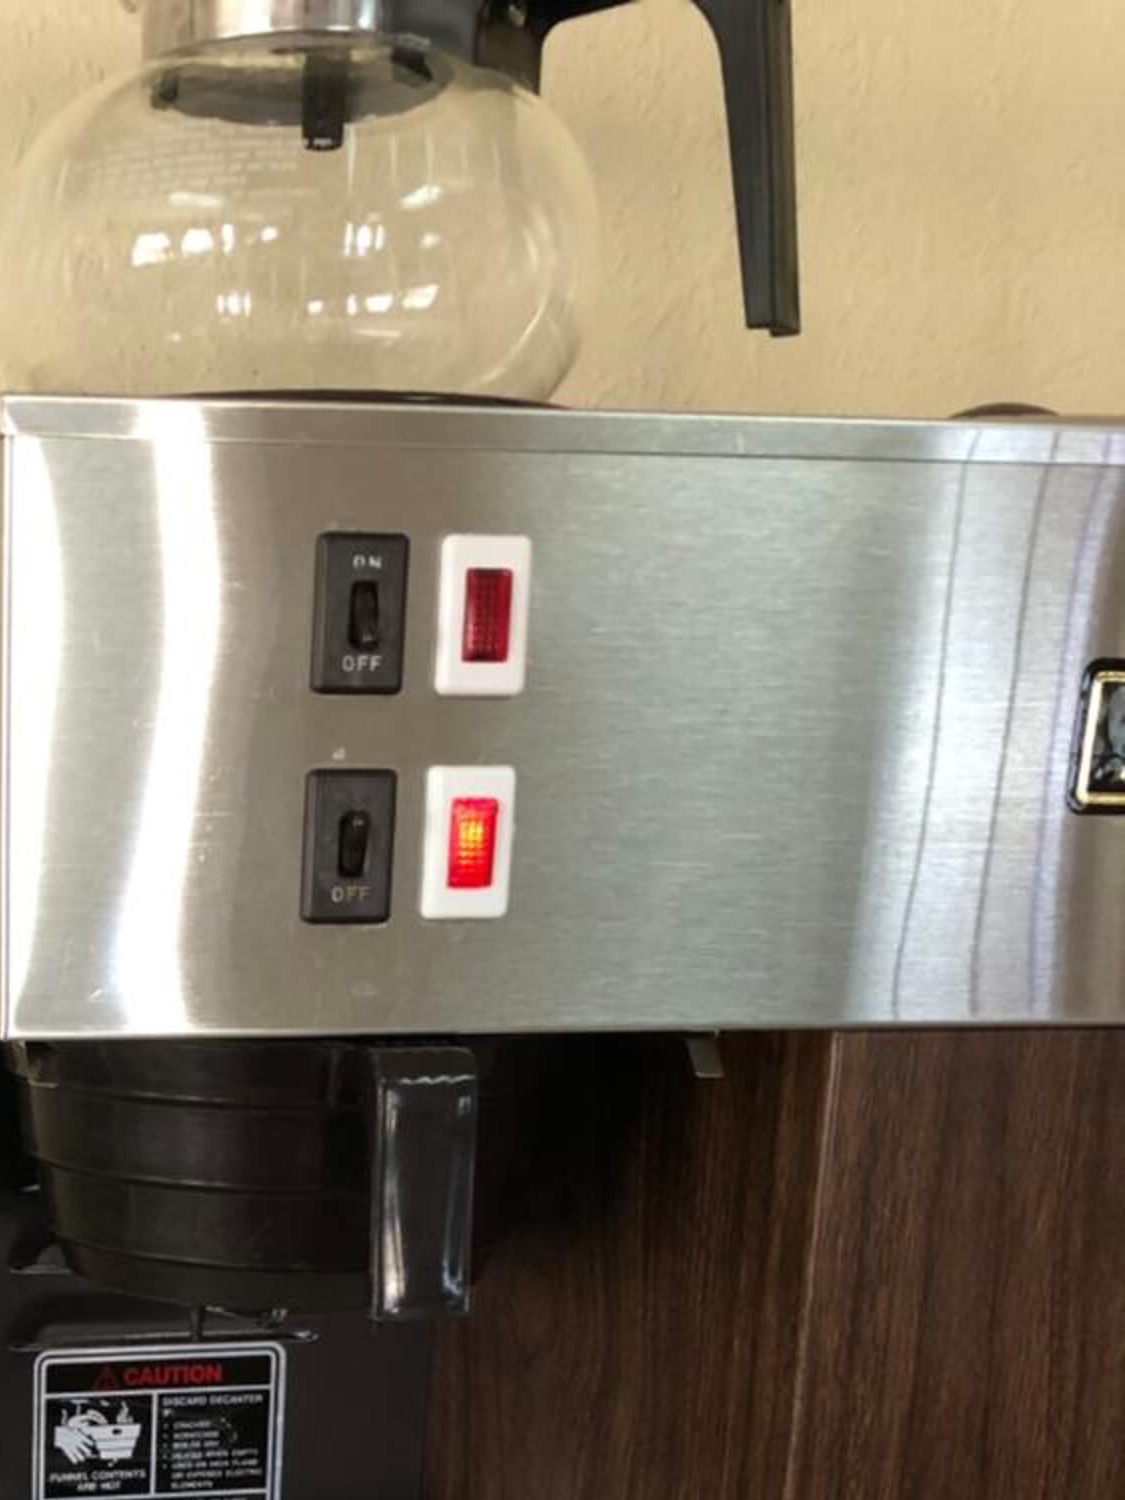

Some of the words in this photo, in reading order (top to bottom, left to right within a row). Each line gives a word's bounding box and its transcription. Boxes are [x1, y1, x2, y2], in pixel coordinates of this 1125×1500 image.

[352, 554, 382, 569] ON
[341, 655, 382, 672] OFF
[331, 885, 372, 903] OFF
[125, 1363, 222, 1386] CAUTION
[90, 1469, 146, 1480] CONTENTS
